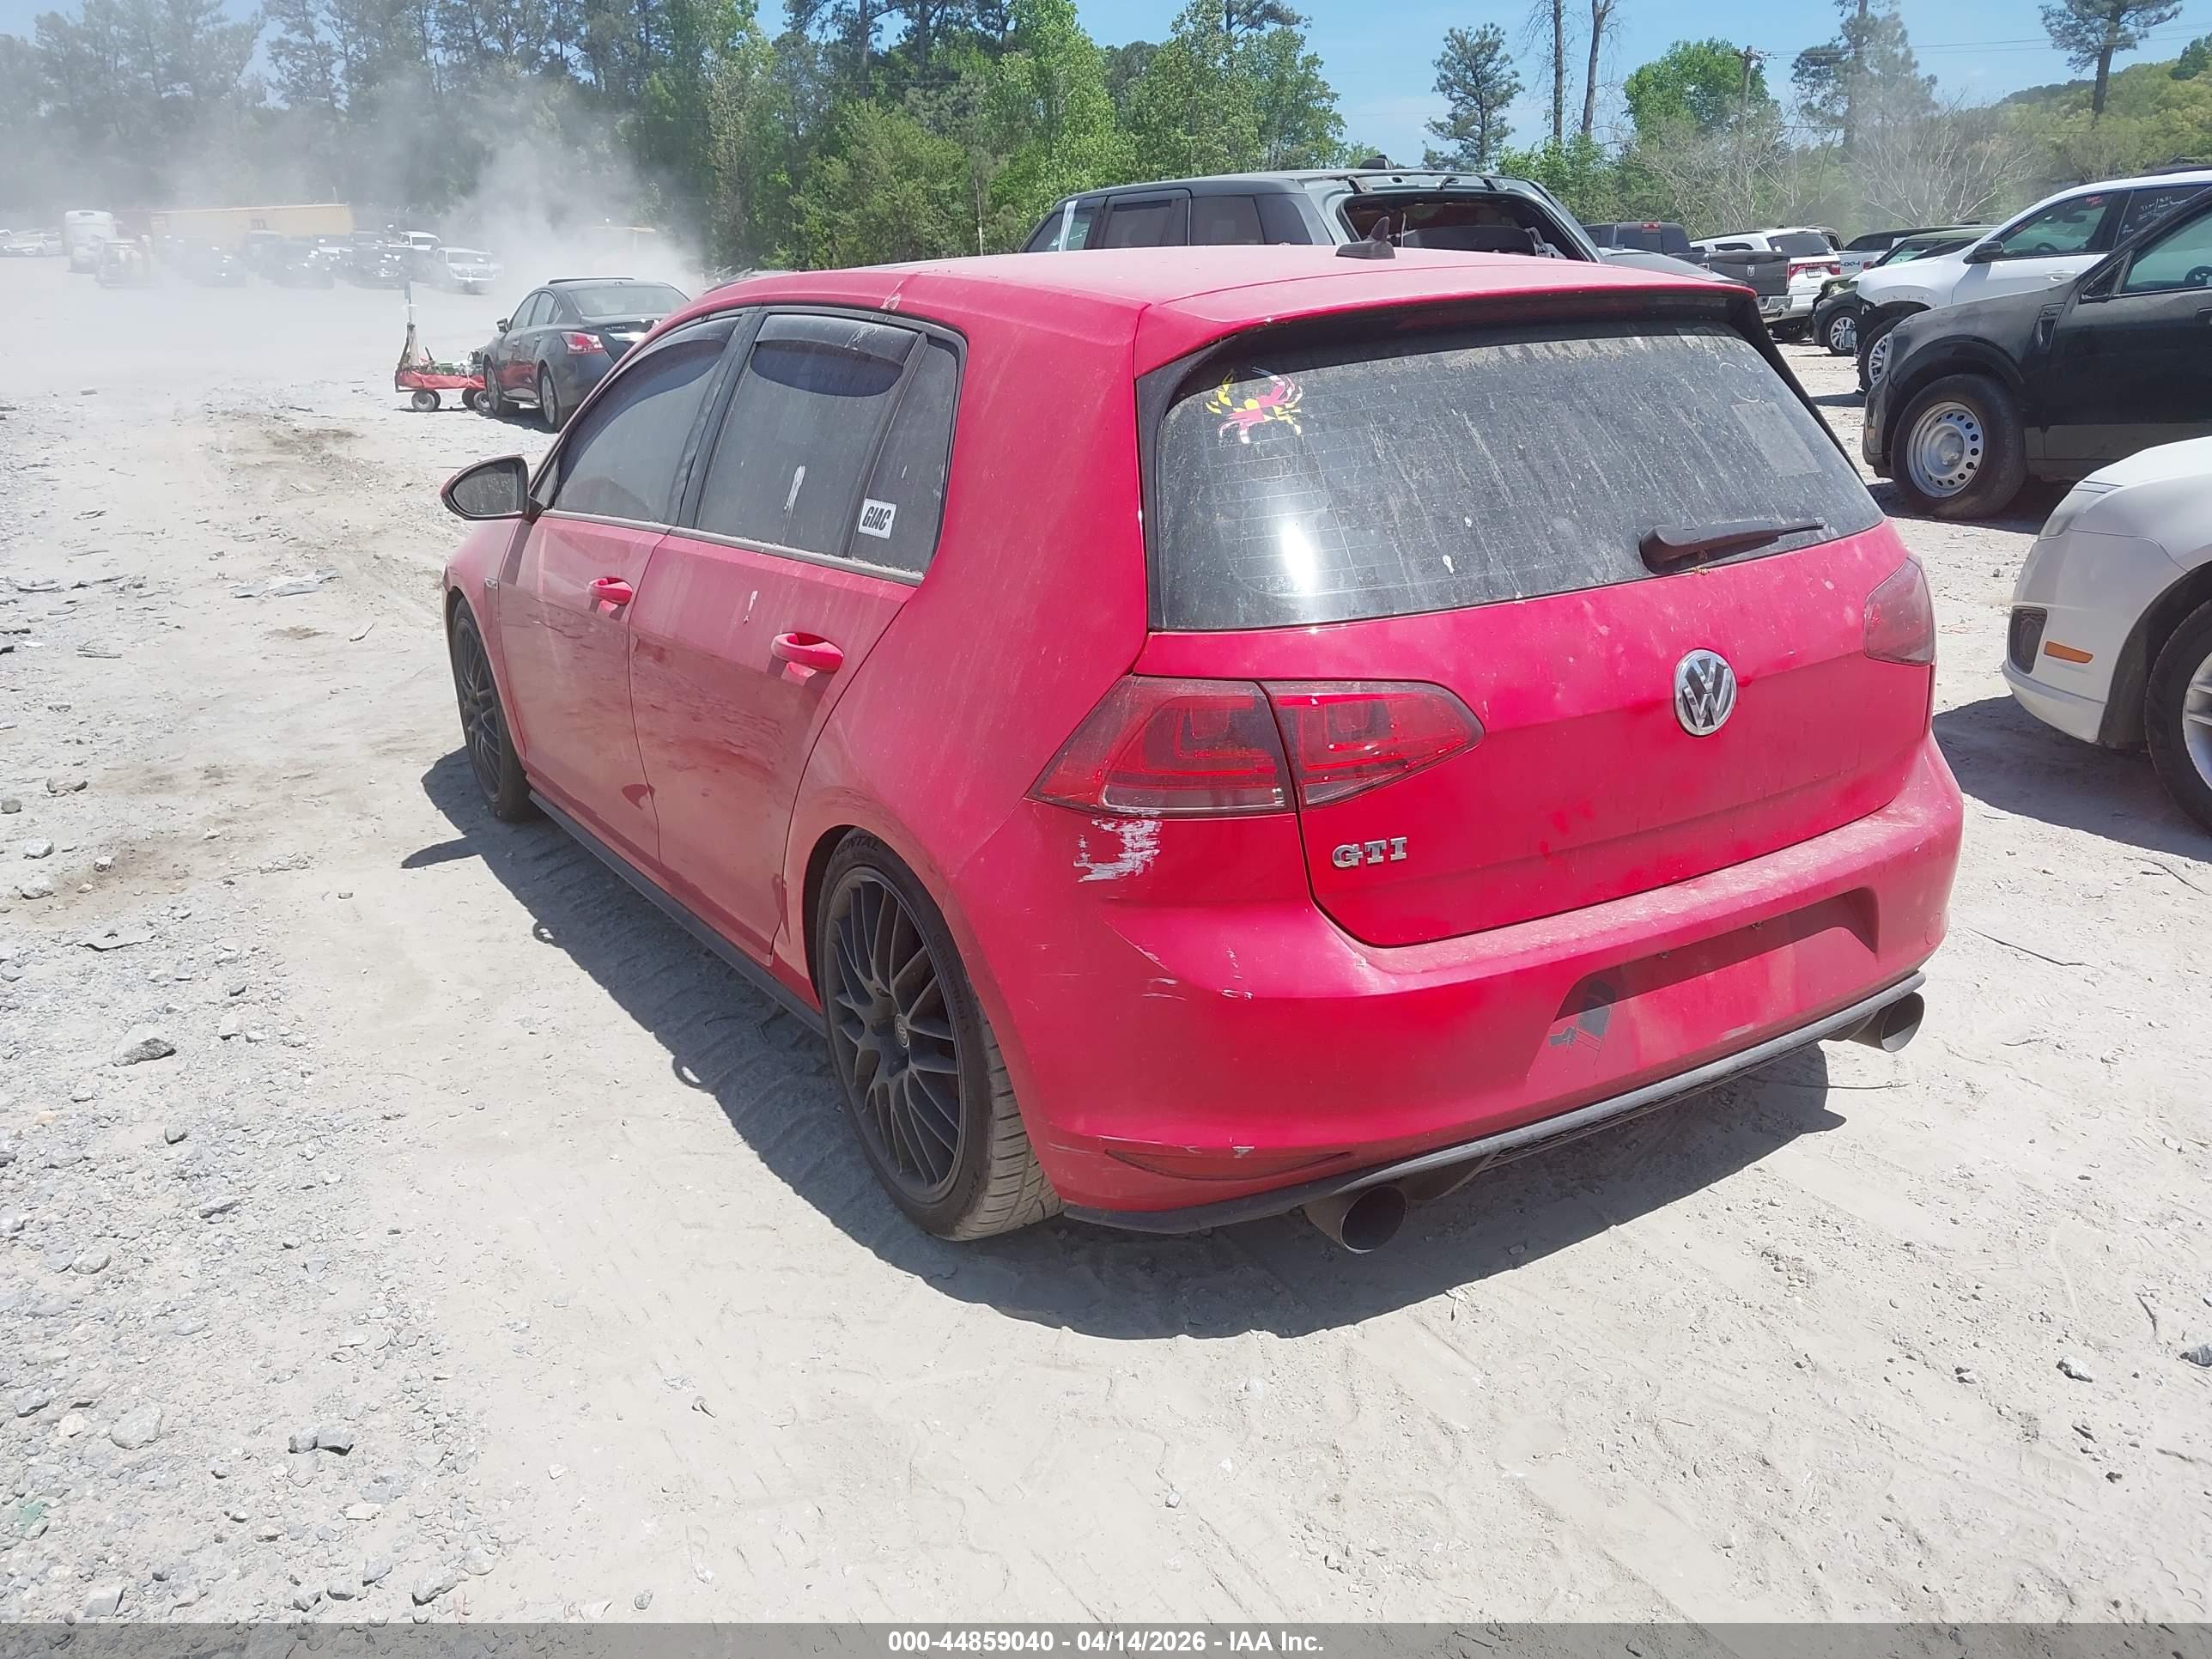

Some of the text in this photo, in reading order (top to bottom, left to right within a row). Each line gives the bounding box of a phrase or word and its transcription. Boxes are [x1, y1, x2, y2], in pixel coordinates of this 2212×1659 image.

[862, 506, 891, 531] GIAC
[1676, 651, 1734, 734] VW
[1333, 837, 1407, 867] GTI
